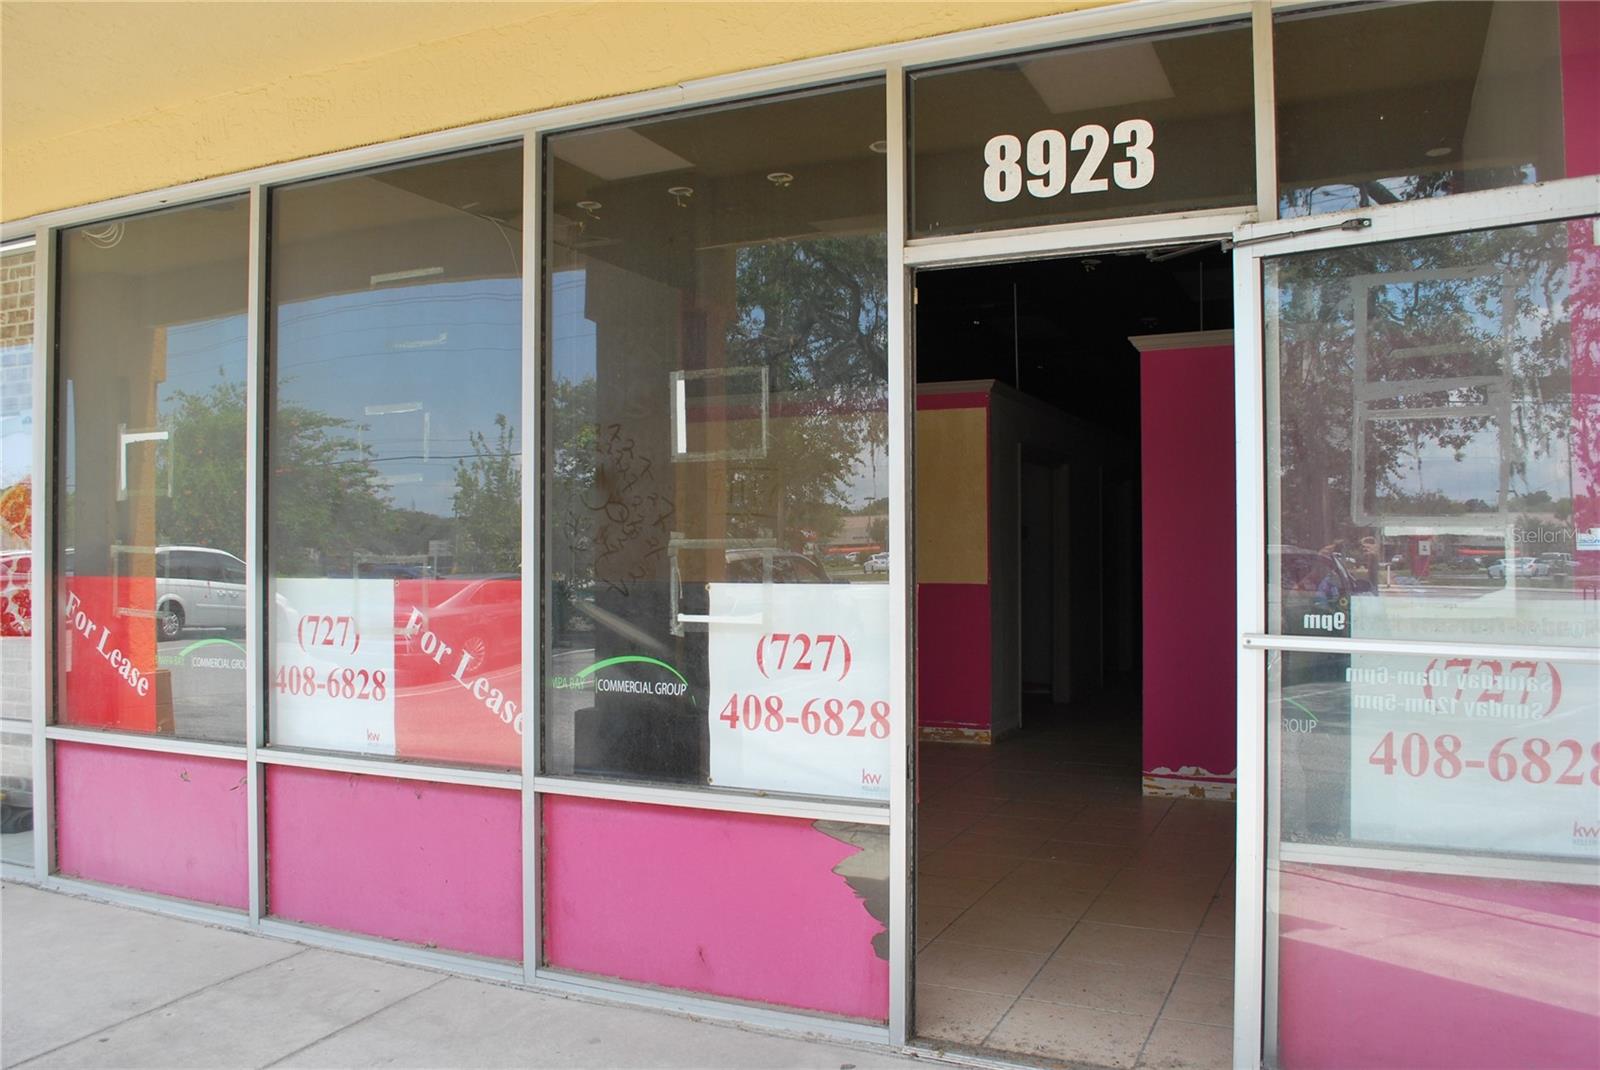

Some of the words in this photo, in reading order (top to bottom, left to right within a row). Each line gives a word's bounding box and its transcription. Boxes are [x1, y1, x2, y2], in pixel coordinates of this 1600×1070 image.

[983, 118, 1155, 203] 8923
[66, 591, 97, 639] For
[96, 625, 149, 697] Lease
[298, 615, 360, 654] (727)
[403, 606, 451, 664] For
[756, 634, 852, 682] (727)
[272, 665, 386, 701] 408-6828
[597, 679, 654, 695] COMMERCIAL
[655, 683, 687, 696] GROUP
[1423, 658, 1562, 718] (727)
[719, 693, 891, 739] 408-6828
[1283, 718, 1317, 733] ROUP
[862, 768, 882, 784] kw
[1573, 821, 1600, 837] kw
